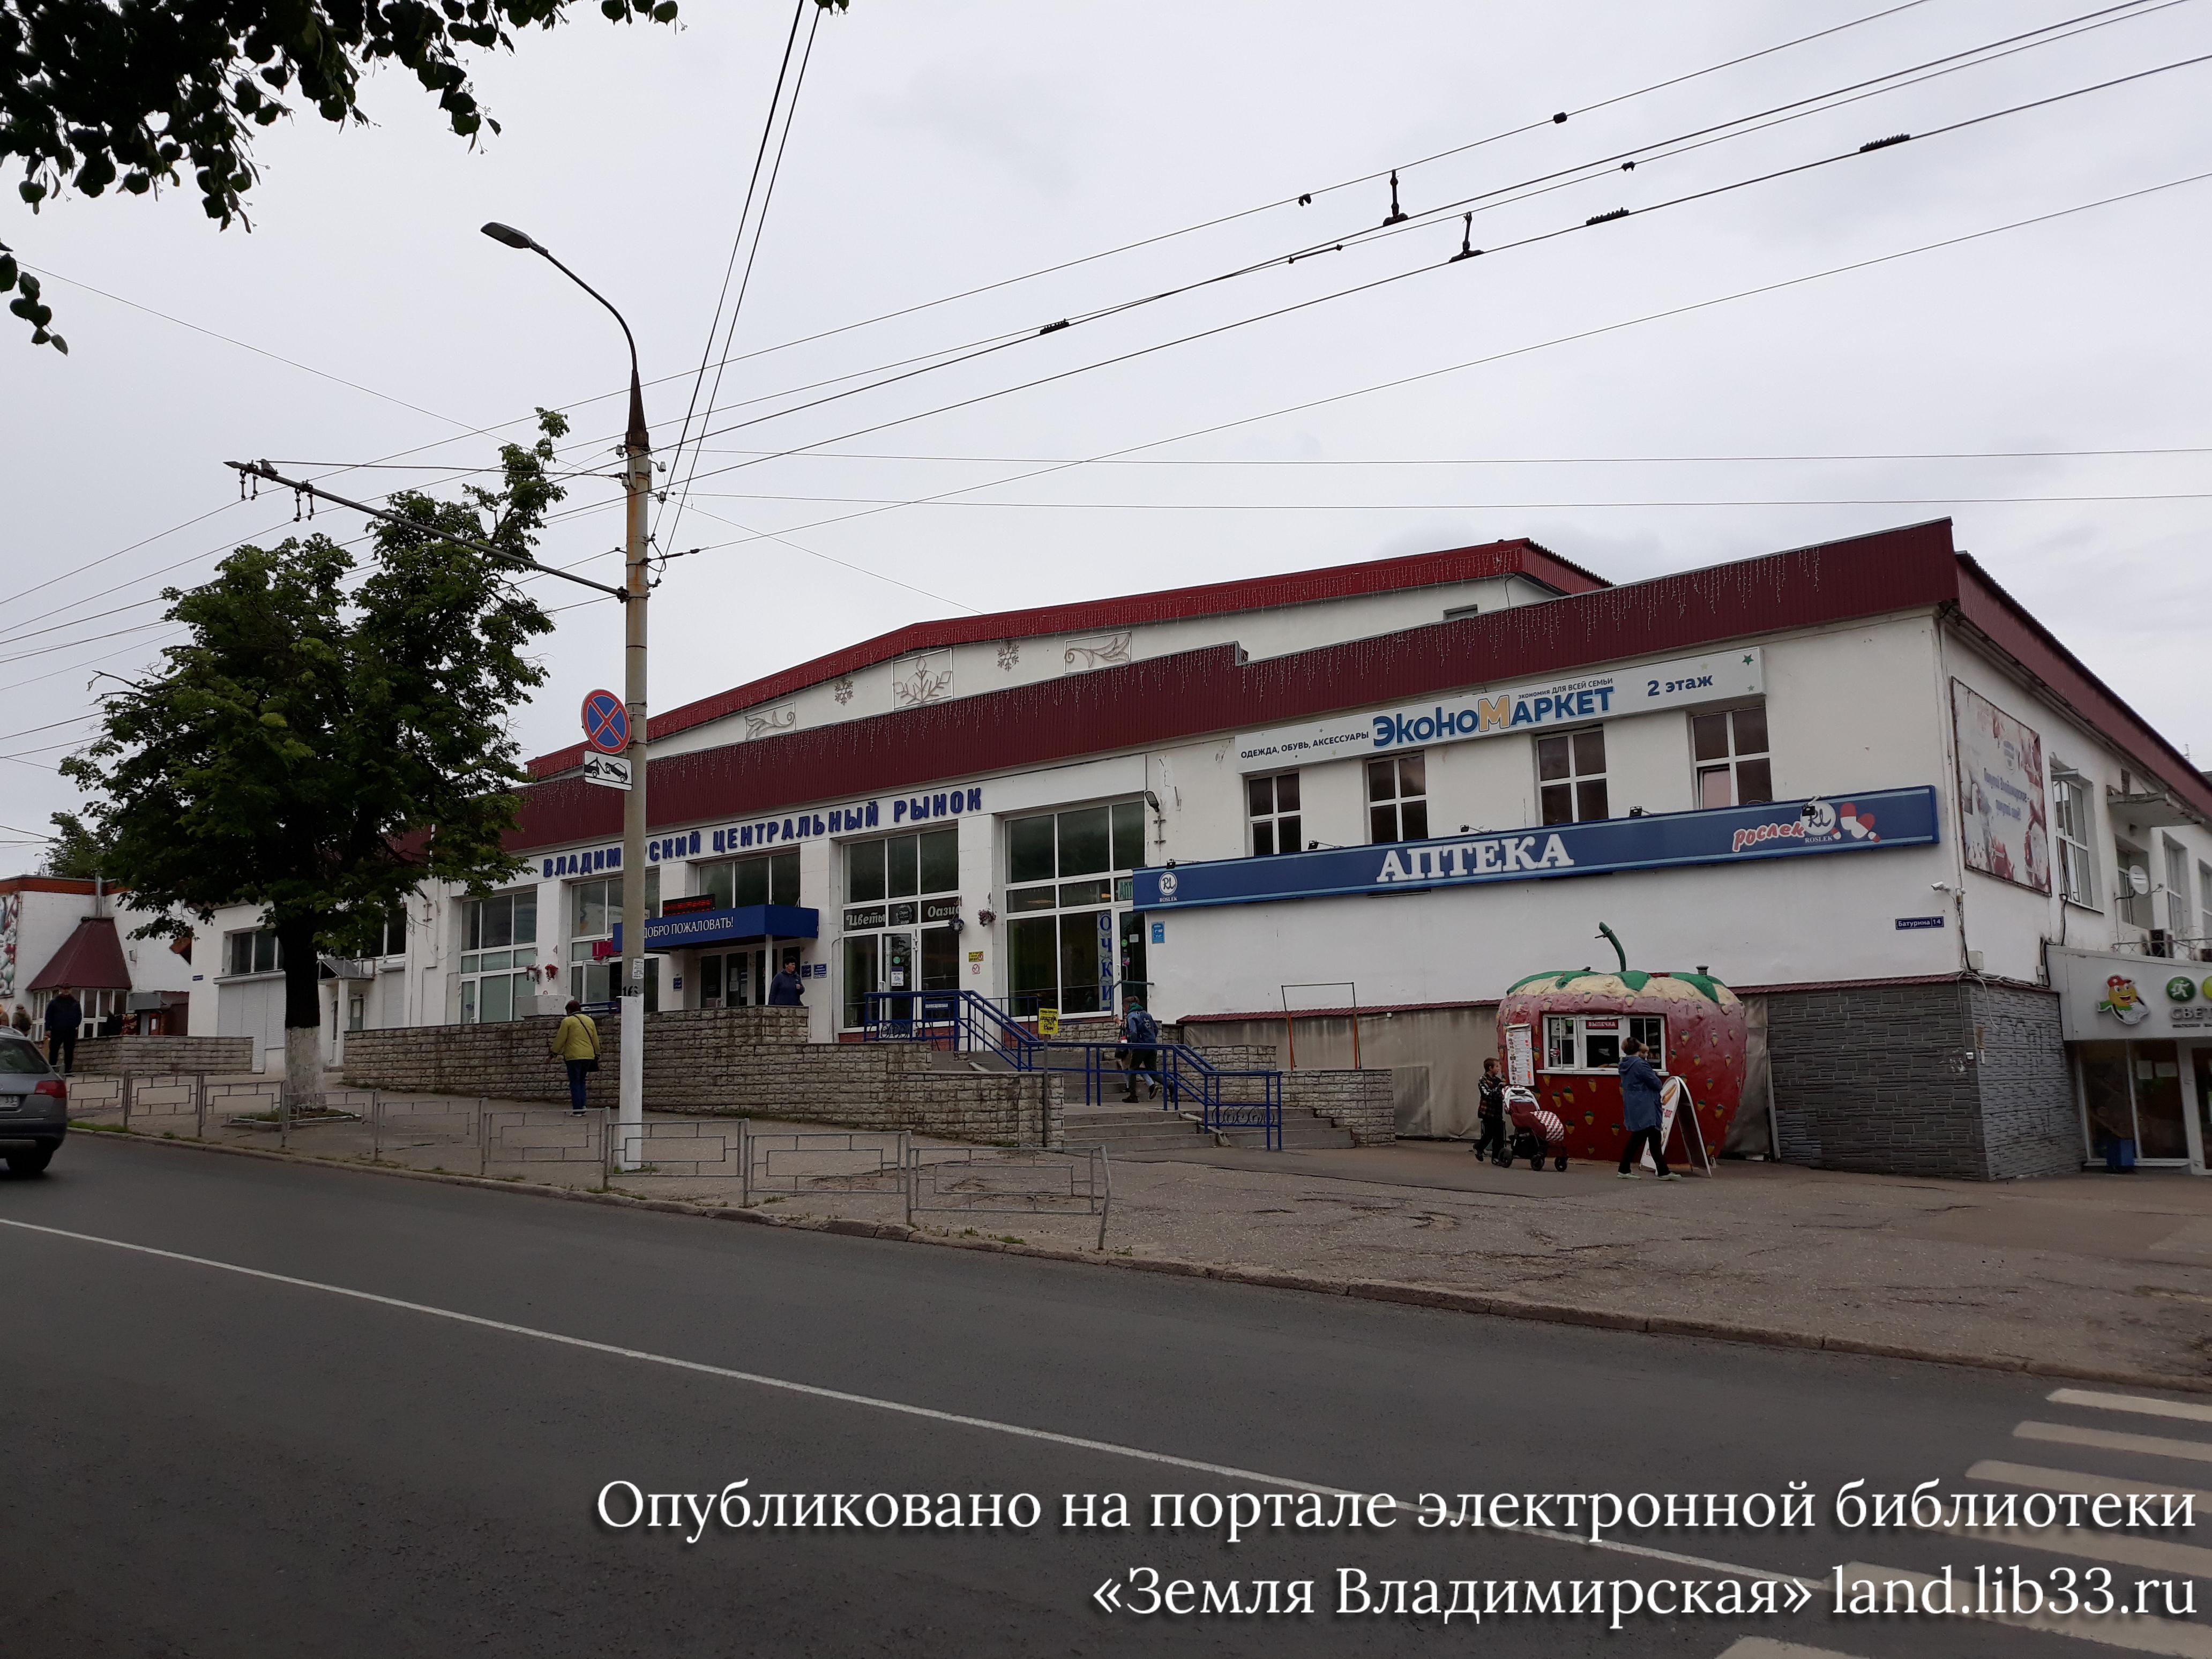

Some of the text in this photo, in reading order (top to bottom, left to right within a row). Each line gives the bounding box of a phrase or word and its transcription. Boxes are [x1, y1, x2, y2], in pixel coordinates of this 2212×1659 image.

[1552, 686, 1566, 694] ДЛЯ
[1568, 681, 1586, 691] ВСЕЙ
[1588, 678, 1613, 687] СЕМЬИ
[1647, 675, 1713, 697] 2 этаж
[1240, 731, 1369, 759] ОДЕЖДА, ОБУВЬ, АКСЕССУАРЫ
[543, 788, 982, 877] ВЛАДИМСКИЙ ЦЕНТРАЛЬНЫЙ РЫНОК
[1805, 835, 1833, 843] ROSLEK
[1376, 833, 1574, 883] АПТЕКА
[671, 916, 734, 934] ПОЖАЛОВАТЬ!
[846, 911, 886, 926] Цветы
